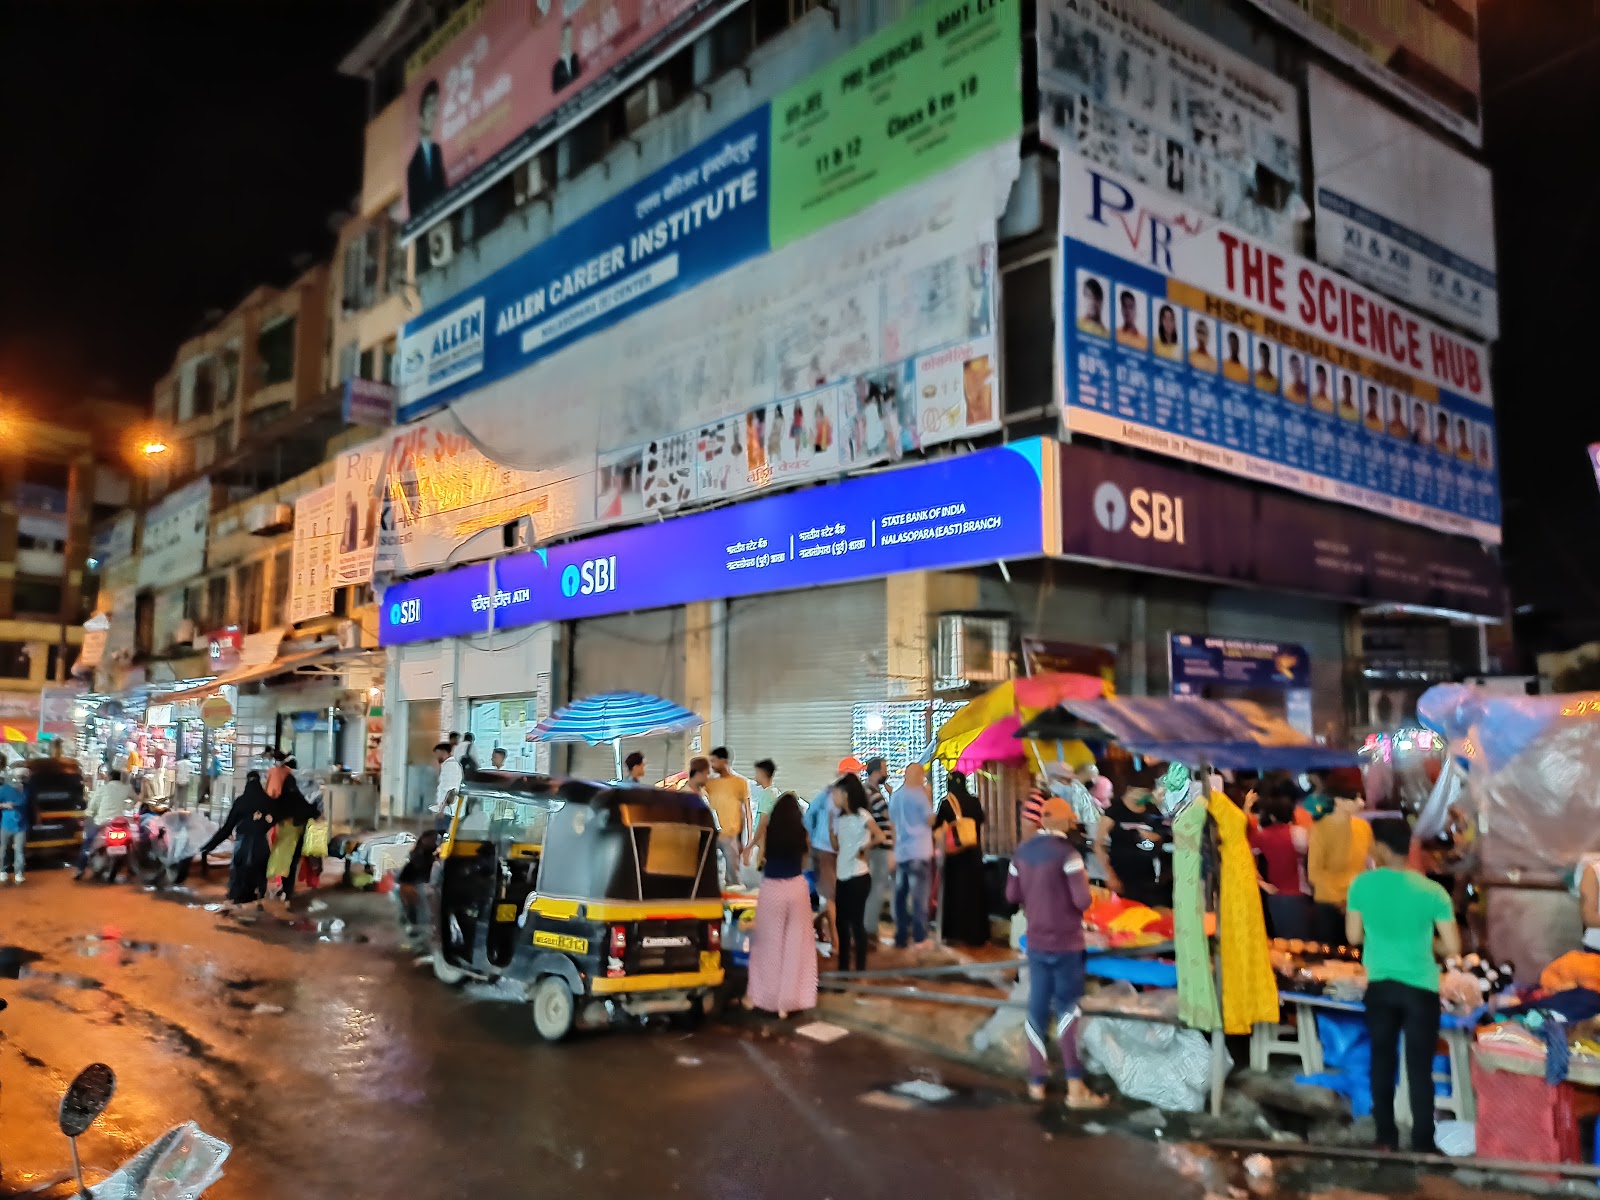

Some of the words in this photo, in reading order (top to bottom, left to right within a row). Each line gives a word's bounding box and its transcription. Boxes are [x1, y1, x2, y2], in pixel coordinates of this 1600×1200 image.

[496, 288, 546, 336] ALLEN
[550, 246, 626, 306] CAREER
[631, 169, 758, 262] INSTITUTE
[1217, 230, 1287, 315] THE
[1298, 267, 1424, 371] SCIENCE
[1430, 322, 1485, 394] HUB
[432, 311, 481, 357] ALLEN
[881, 514, 905, 528] STATE
[906, 510, 928, 523] BANK
[928, 508, 941, 519] OF
[941, 503, 966, 517] INDIA
[881, 528, 934, 546] NALASOPARA
[935, 523, 962, 538] (EAST)
[963, 516, 1001, 533] BRANCH
[1130, 488, 1184, 545] SBI
[581, 555, 618, 596] SBI
[400, 598, 421, 624] SBI
